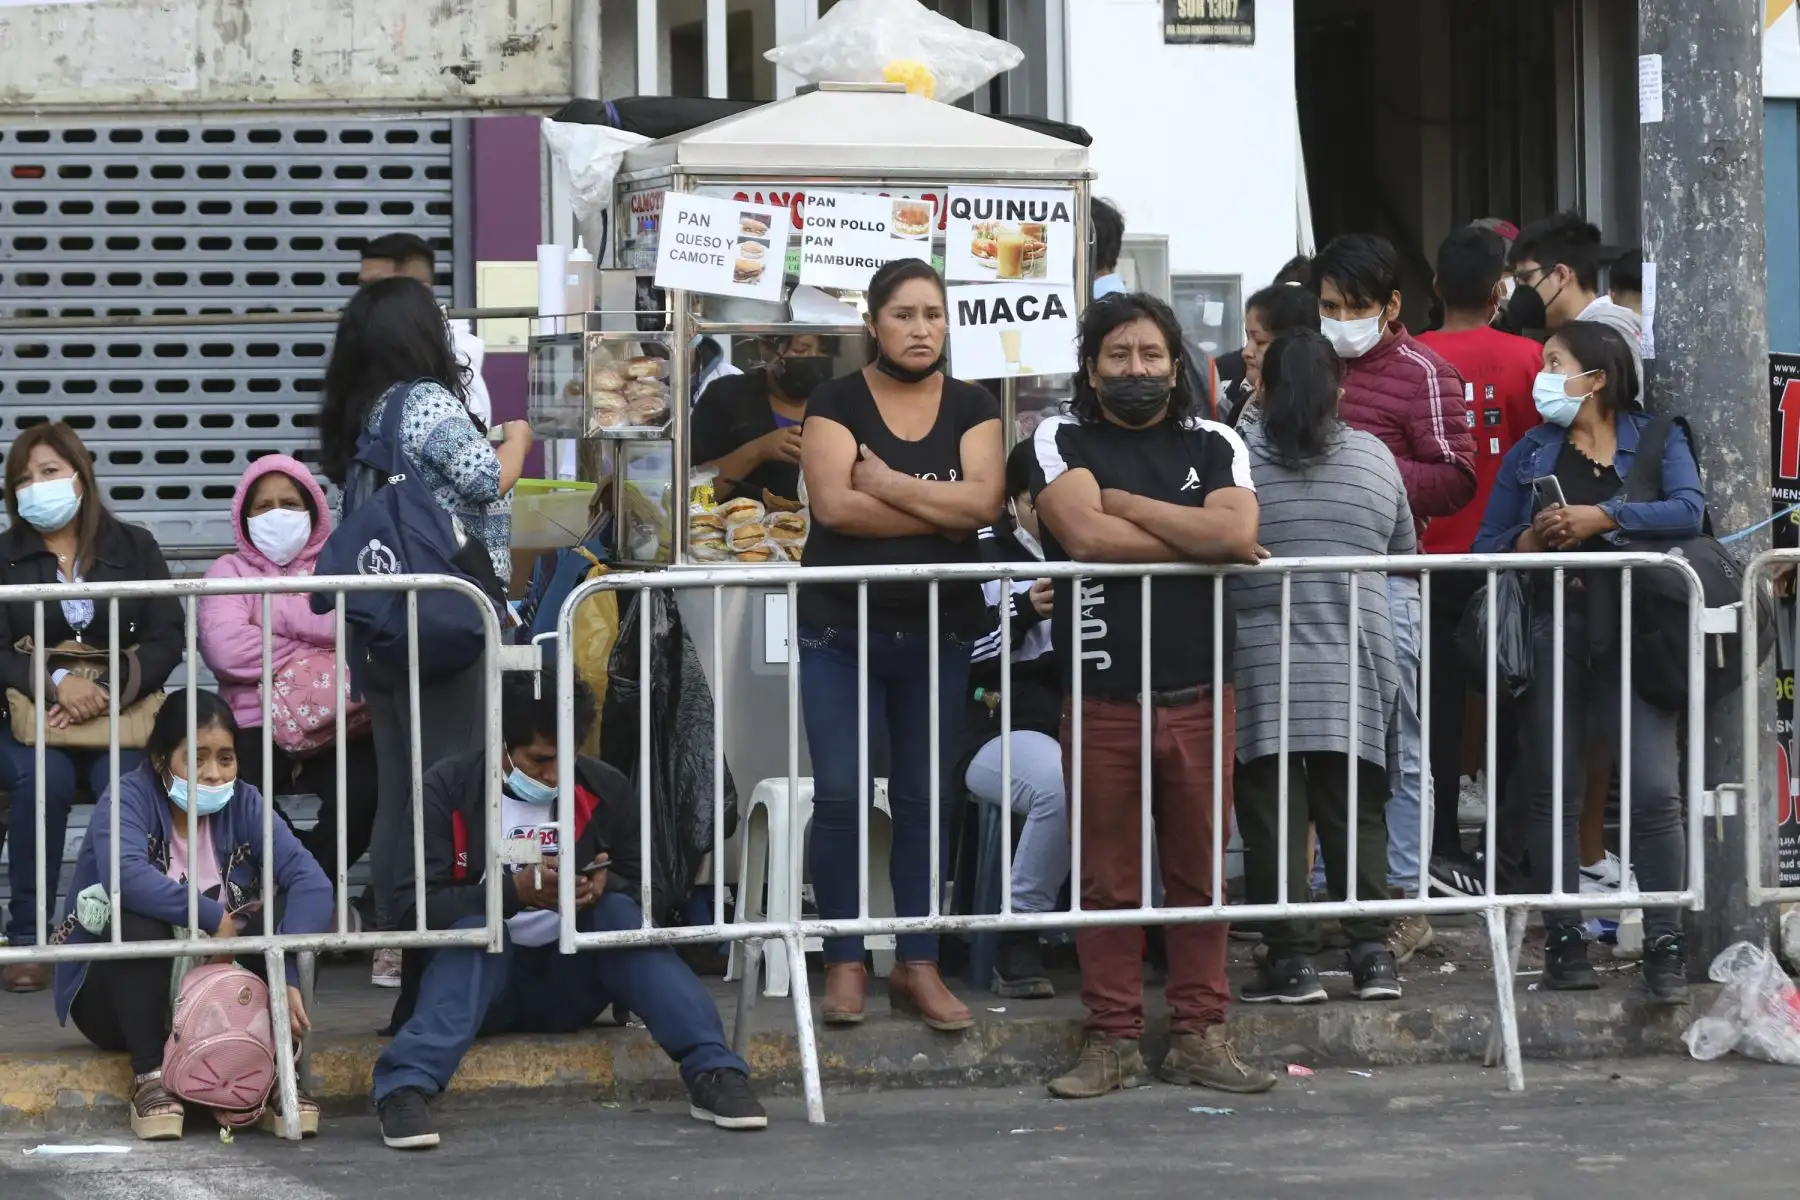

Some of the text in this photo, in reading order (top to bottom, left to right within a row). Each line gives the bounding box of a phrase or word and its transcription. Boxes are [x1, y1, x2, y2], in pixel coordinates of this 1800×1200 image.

[807, 195, 836, 208] PAN
[950, 197, 1070, 223] QUINUA
[678, 211, 711, 228] PAN
[806, 216, 886, 233] CON POLLO
[675, 232, 734, 250] QUESO Y
[805, 235, 833, 247] PAN
[669, 248, 725, 266] CAMOTE
[804, 253, 888, 269] HAMBURGU
[957, 293, 1068, 326] MACA
[1080, 577, 1112, 670] JUAR
